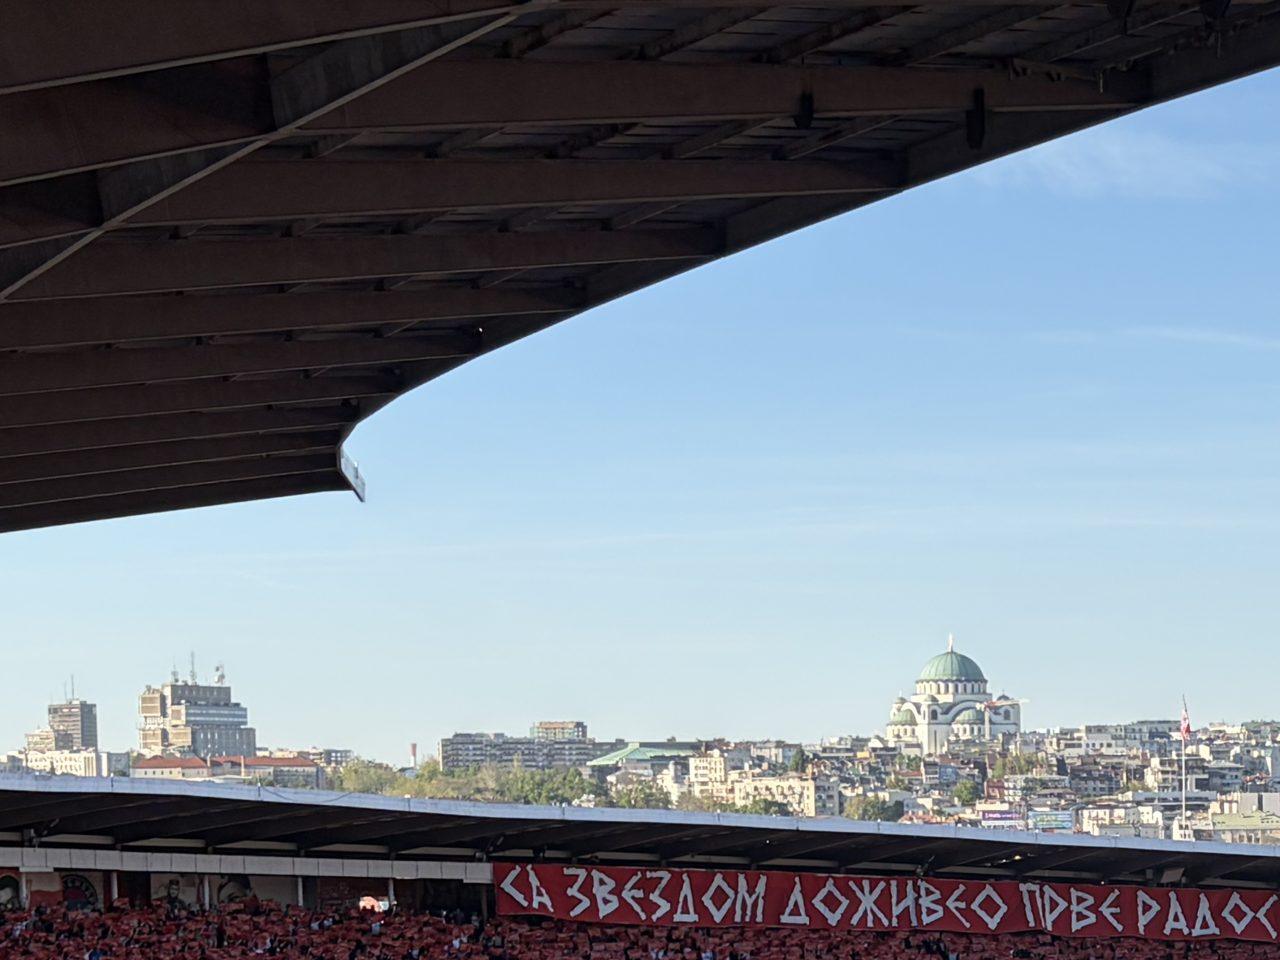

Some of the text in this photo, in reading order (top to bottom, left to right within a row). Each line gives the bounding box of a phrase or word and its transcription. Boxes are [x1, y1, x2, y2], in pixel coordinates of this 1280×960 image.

[499, 864, 553, 912] СА
[563, 867, 767, 924] ЗВЕЗДОМ
[780, 876, 1008, 930] ДОЖИВЕО
[1019, 882, 1124, 933] ПРВЕ
